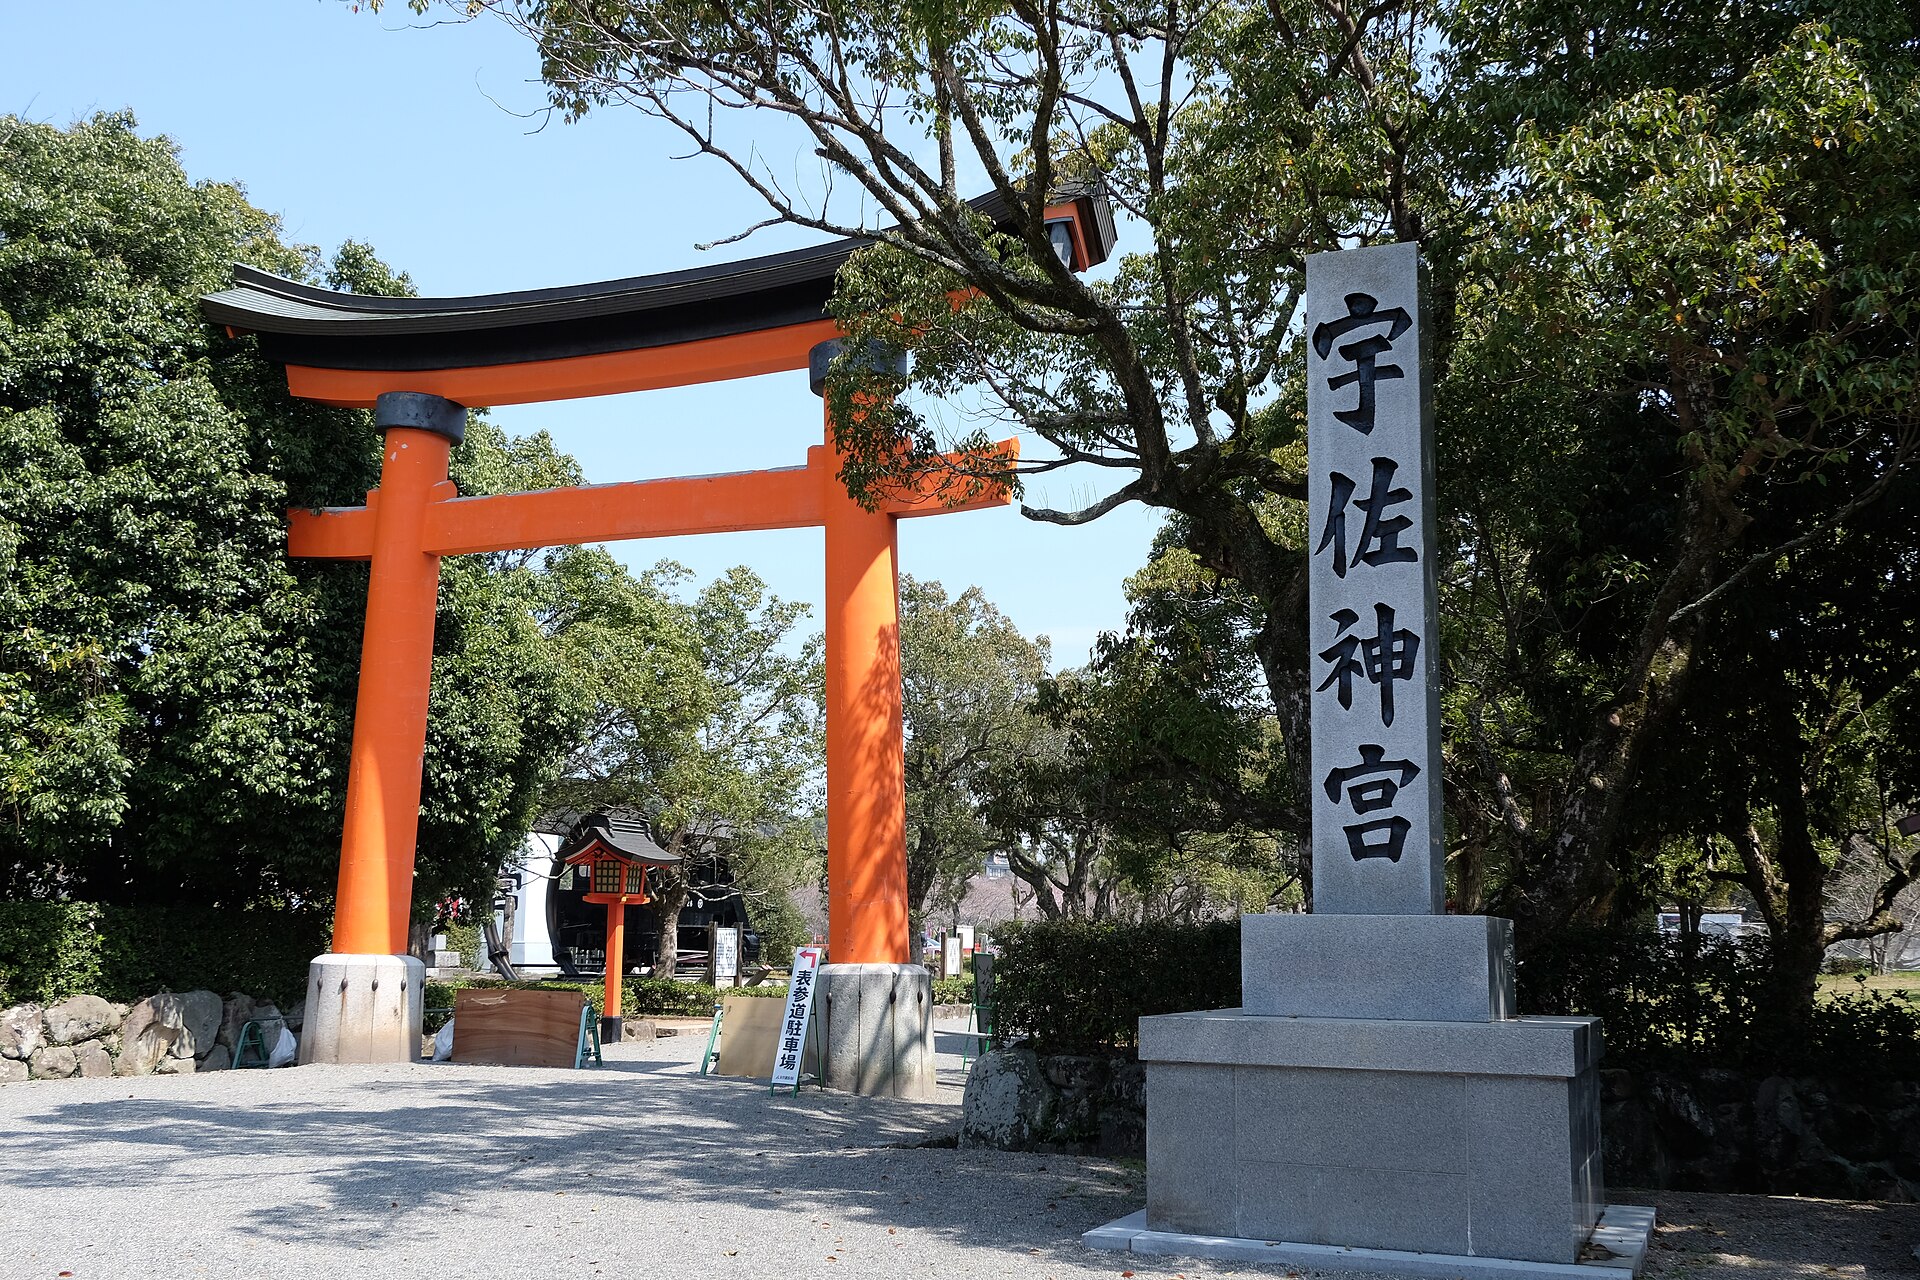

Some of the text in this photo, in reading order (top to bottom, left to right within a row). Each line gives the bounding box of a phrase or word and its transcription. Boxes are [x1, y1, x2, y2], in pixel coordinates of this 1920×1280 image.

[1312, 292, 1421, 863] 宇佐神宮
[779, 969, 812, 1071] 表参道駐車場
